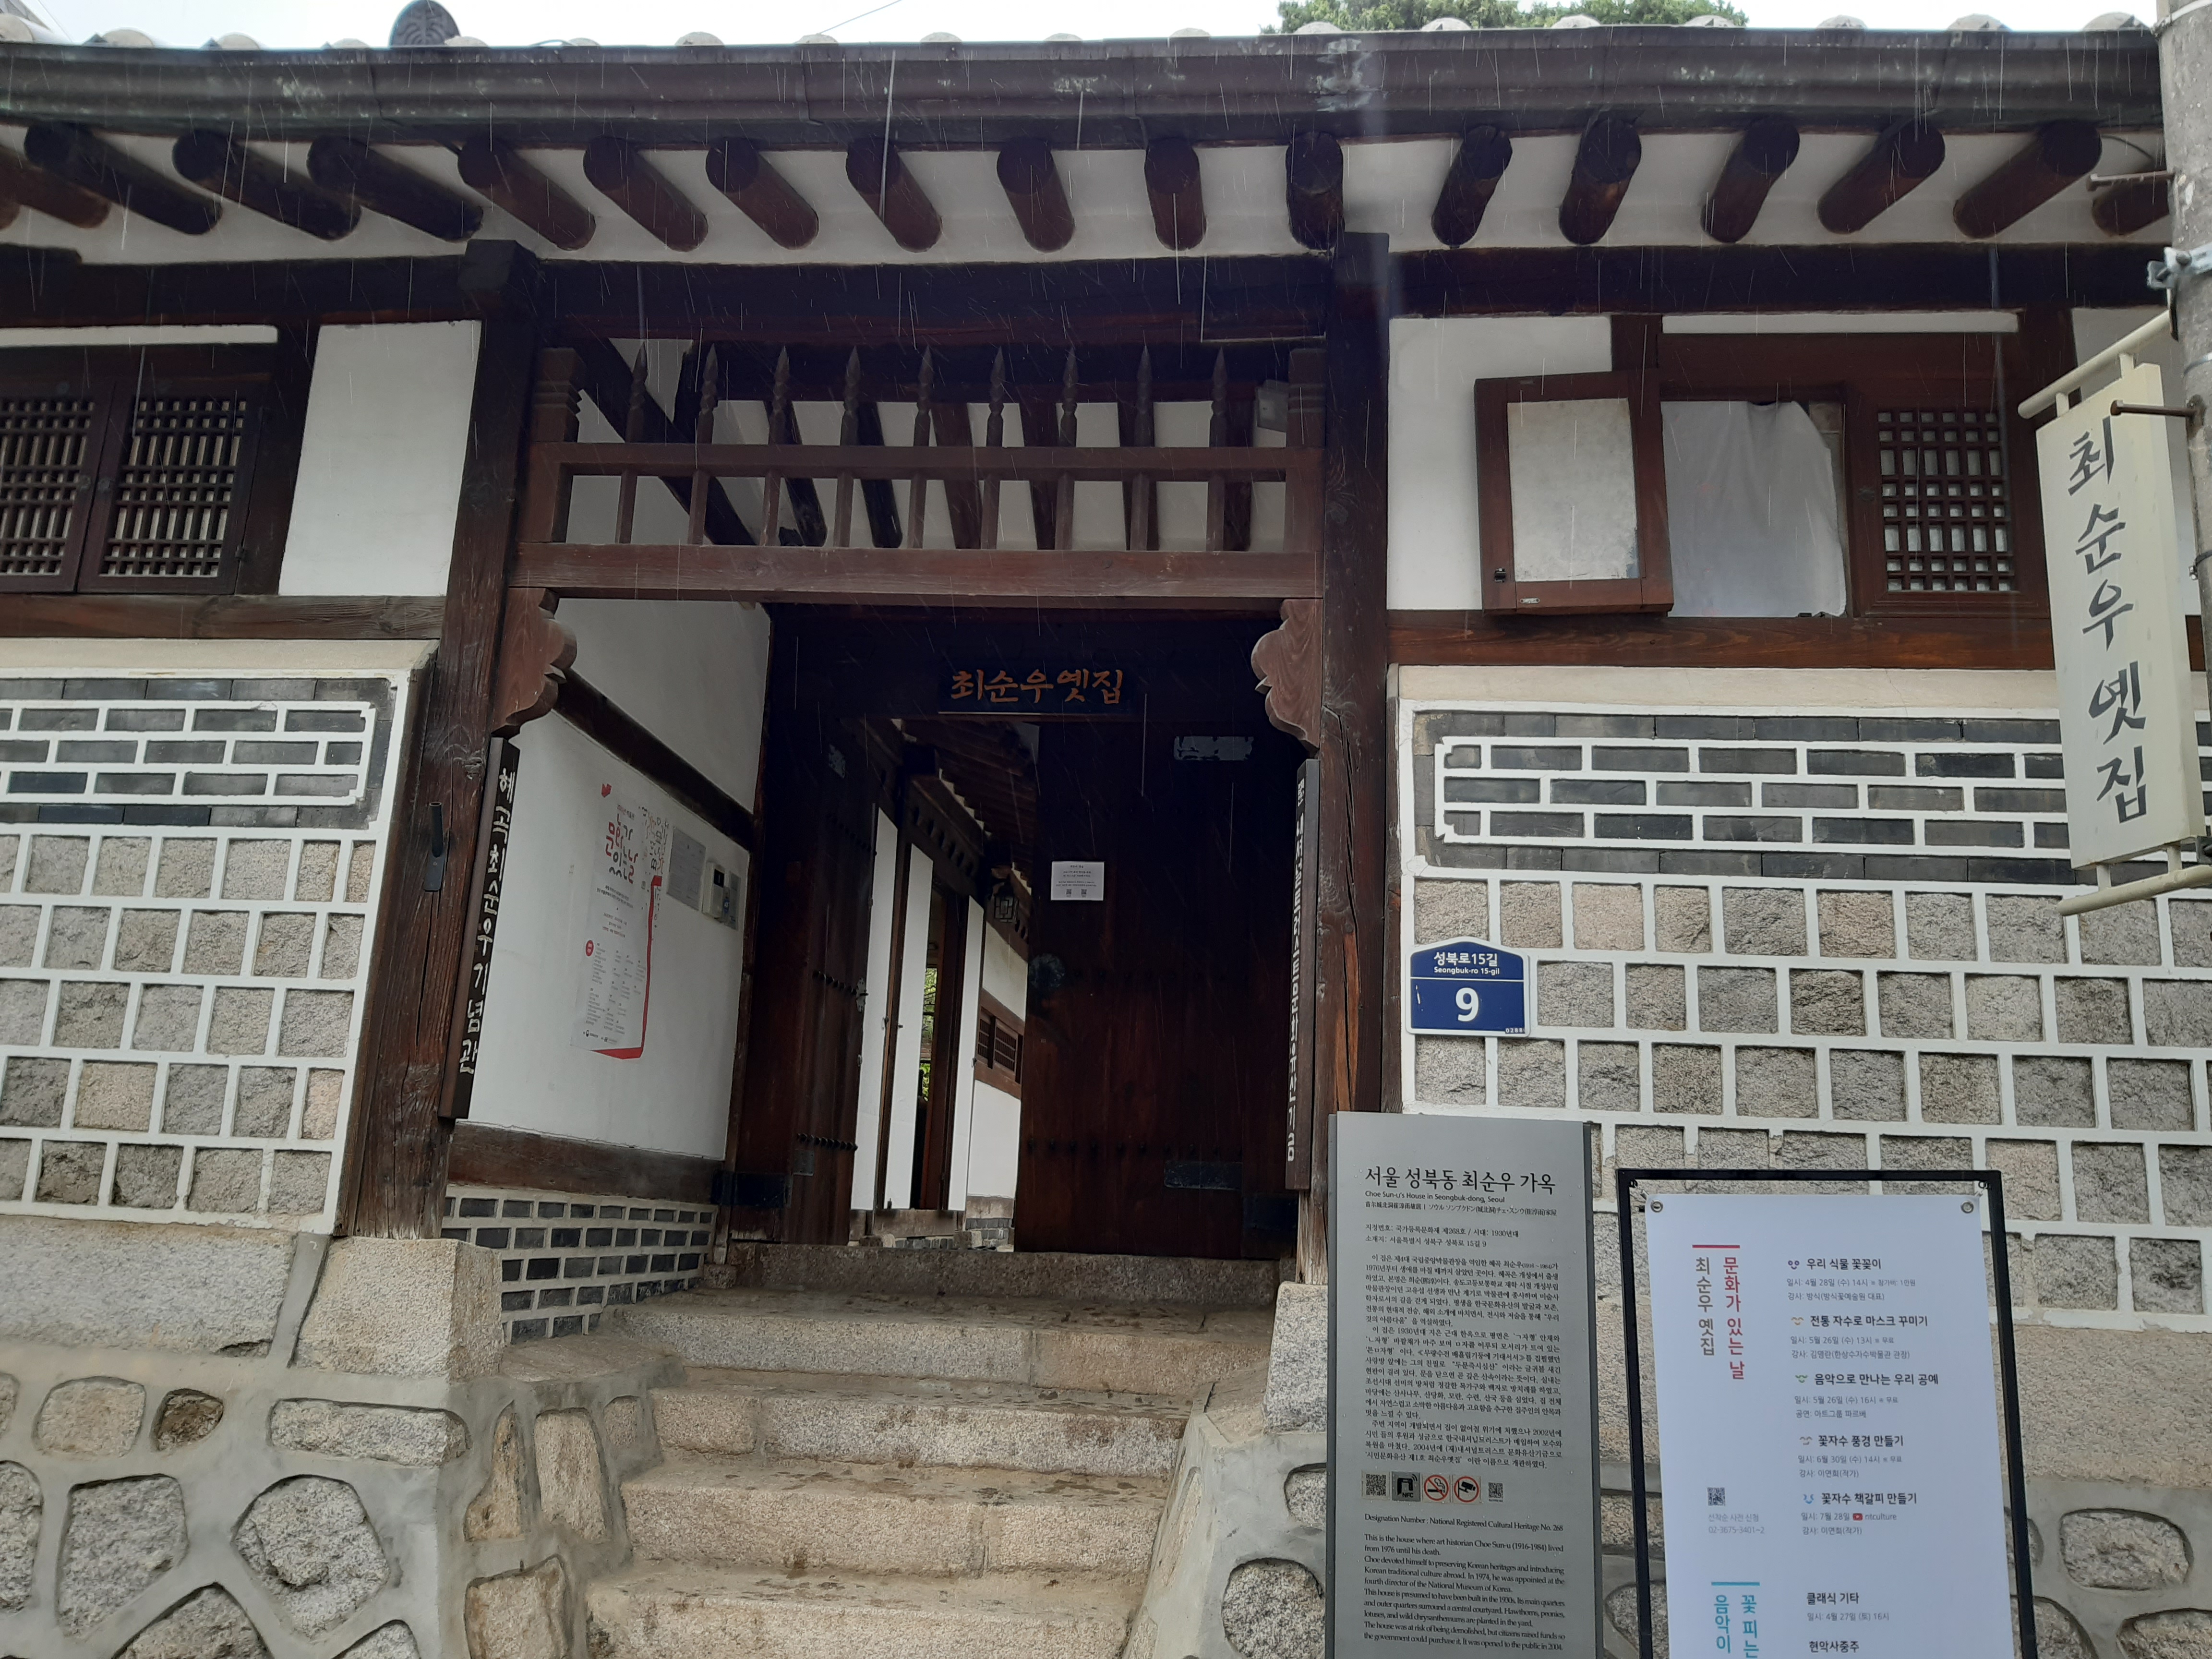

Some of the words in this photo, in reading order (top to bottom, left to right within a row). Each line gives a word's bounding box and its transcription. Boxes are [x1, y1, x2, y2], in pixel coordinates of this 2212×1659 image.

[1434, 951, 1498, 967] 성북로15길
[1455, 987, 1479, 1022] 9
[1365, 1166, 1400, 1188] 서울
[1405, 1168, 1457, 1190] 성북동
[1462, 1170, 1515, 1192] 최순우
[1520, 1173, 1555, 1195] 가옥
[1435, 1194, 1485, 1203] Seongbuk-dong,
[1806, 1258, 1826, 1270] 우리
[1829, 1258, 1849, 1270] 식물
[1851, 1258, 1881, 1270] 꽃꽂이
[1695, 1257, 1713, 1313] 최순우
[1723, 1256, 1742, 1312] 문화가
[1787, 1278, 1803, 1286] 일시:
[1805, 1278, 1816, 1286] 4월
[1819, 1279, 1835, 1287] 28일
[1838, 1279, 1850, 1287] (수)
[1788, 1292, 1804, 1300] 강사:
[1810, 1315, 1830, 1327] 전통
[1833, 1315, 1863, 1327] 자수로
[1865, 1315, 1896, 1327] 마스크
[1899, 1315, 1928, 1327] 꾸미기
[1698, 1318, 1715, 1356] 옛집
[1727, 1318, 1744, 1356] 있는
[1790, 1336, 1807, 1344] 일시:
[1809, 1336, 1820, 1345] 5월
[1823, 1336, 1839, 1345] 26일
[1841, 1336, 1853, 1345] (수)
[1791, 1350, 1808, 1358] 강사:
[1730, 1360, 1745, 1380] 날
[1814, 1373, 1857, 1385] 음악으로
[1859, 1373, 1891, 1385] 만나는
[1894, 1373, 1914, 1385] 우리
[1918, 1373, 1938, 1386] 공예
[1794, 1396, 1810, 1405] 일시:
[1813, 1396, 1824, 1405] 5월
[1827, 1396, 1843, 1405] 26일
[1846, 1396, 1858, 1405] (수)
[1796, 1409, 1812, 1419] 공연:
[1818, 1435, 1849, 1447] 꽃자수
[1851, 1435, 1871, 1448] 풍경
[1874, 1435, 1903, 1447] 만들기
[1798, 1455, 1815, 1464] 일시:
[1817, 1455, 1828, 1464] 6월
[1831, 1455, 1847, 1464] 30일
[1849, 1455, 1862, 1464] (수)
[1864, 1455, 1880, 1464] 14시
[1799, 1469, 1815, 1478] 강사:
[1821, 1492, 1852, 1505] 꽃자수
[1854, 1492, 1884, 1505] 책갈피
[1887, 1492, 1917, 1505] 만들기
[1708, 1514, 1728, 1522] 선착순
[1801, 1512, 1817, 1521] 일시:
[1820, 1512, 1831, 1521] 7월
[1834, 1513, 1850, 1521] 28일
[1365, 1514, 1399, 1523] Designation
[1456, 1519, 1487, 1528] Registered
[1514, 1522, 1539, 1532] Heritage
[1803, 1527, 1818, 1536] 강사:
[1512, 1543, 1547, 1552] (1916-1984)
[1741, 1595, 1757, 1614] 꽃
[1806, 1592, 1836, 1605] 클래식
[1839, 1592, 1859, 1604] 기타
[1807, 1612, 1823, 1622] 일시:
[1826, 1612, 1837, 1621] 4월
[1714, 1595, 1731, 1654] 음악이
[1809, 1640, 1859, 1653] 현악사중주
